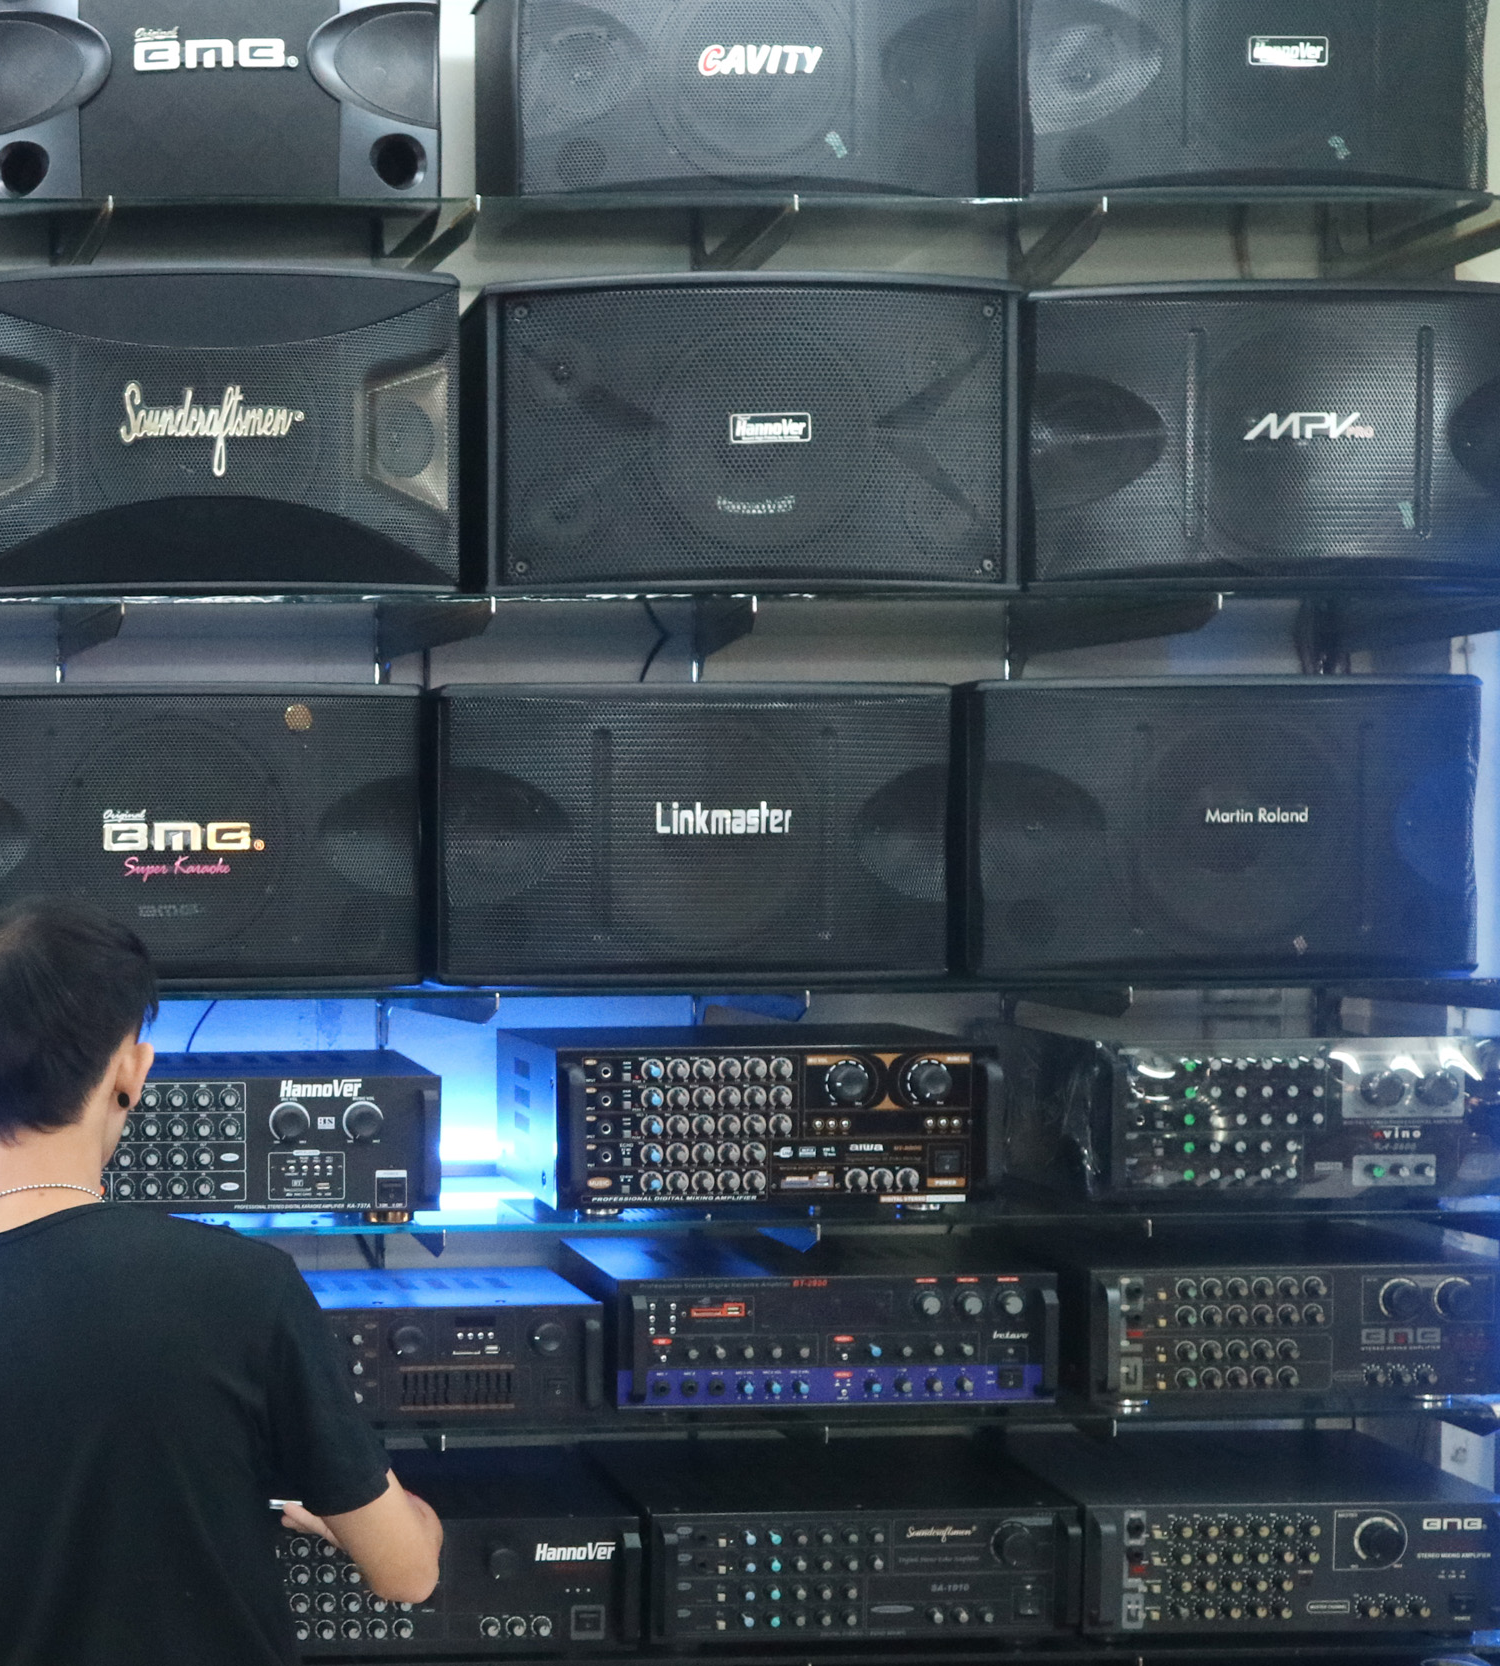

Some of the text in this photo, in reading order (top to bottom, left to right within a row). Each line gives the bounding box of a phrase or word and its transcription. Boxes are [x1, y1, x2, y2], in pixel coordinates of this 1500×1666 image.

[134, 26, 179, 42] Original
[1253, 39, 1324, 59] HannoVer
[698, 44, 823, 76] CAVITY
[120, 383, 294, 476] Soundcraftsmen
[735, 417, 806, 436] HannoVer
[1243, 412, 1360, 440] MPV
[103, 809, 146, 823] Original
[656, 801, 792, 834] Linkmaster
[1205, 805, 1308, 823] Martin Roland
[124, 855, 231, 882] Super Karaoke
[280, 1079, 362, 1098] HannoVer
[535, 1542, 616, 1562] HannoVer
